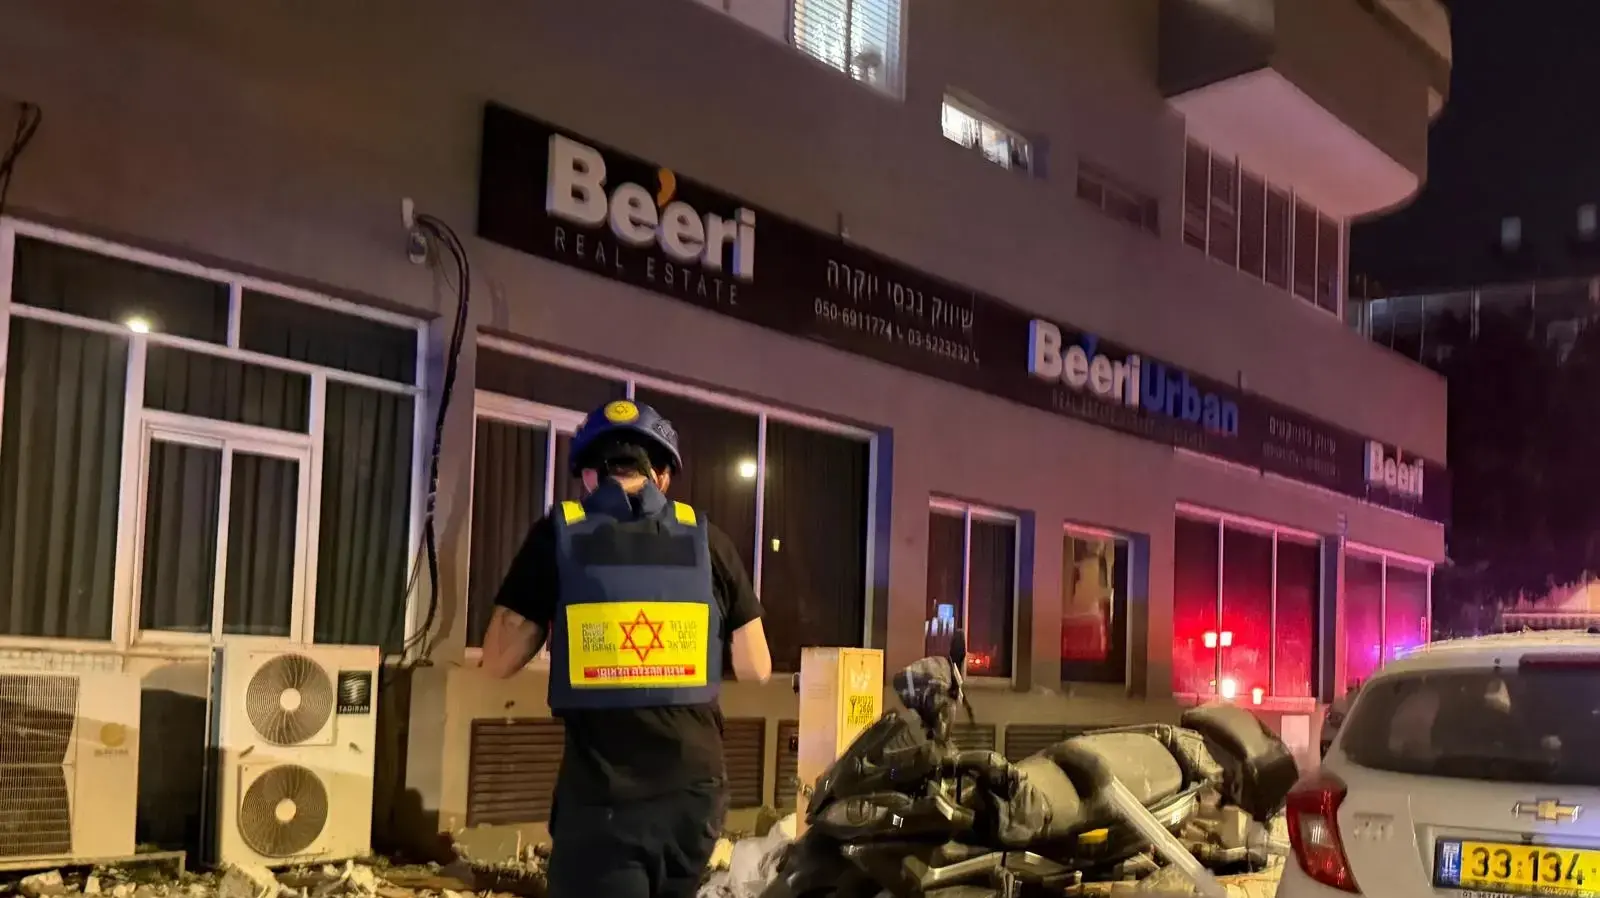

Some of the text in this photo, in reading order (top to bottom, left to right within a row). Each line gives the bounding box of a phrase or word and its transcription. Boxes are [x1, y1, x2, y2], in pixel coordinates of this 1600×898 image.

[546, 132, 756, 282] Be'eri
[554, 226, 739, 306] REAL ESTATE
[827, 259, 975, 333] שיווק נכסי יוקרה
[814, 297, 893, 343] 050-6911774
[339, 705, 369, 713] TADIRAN
